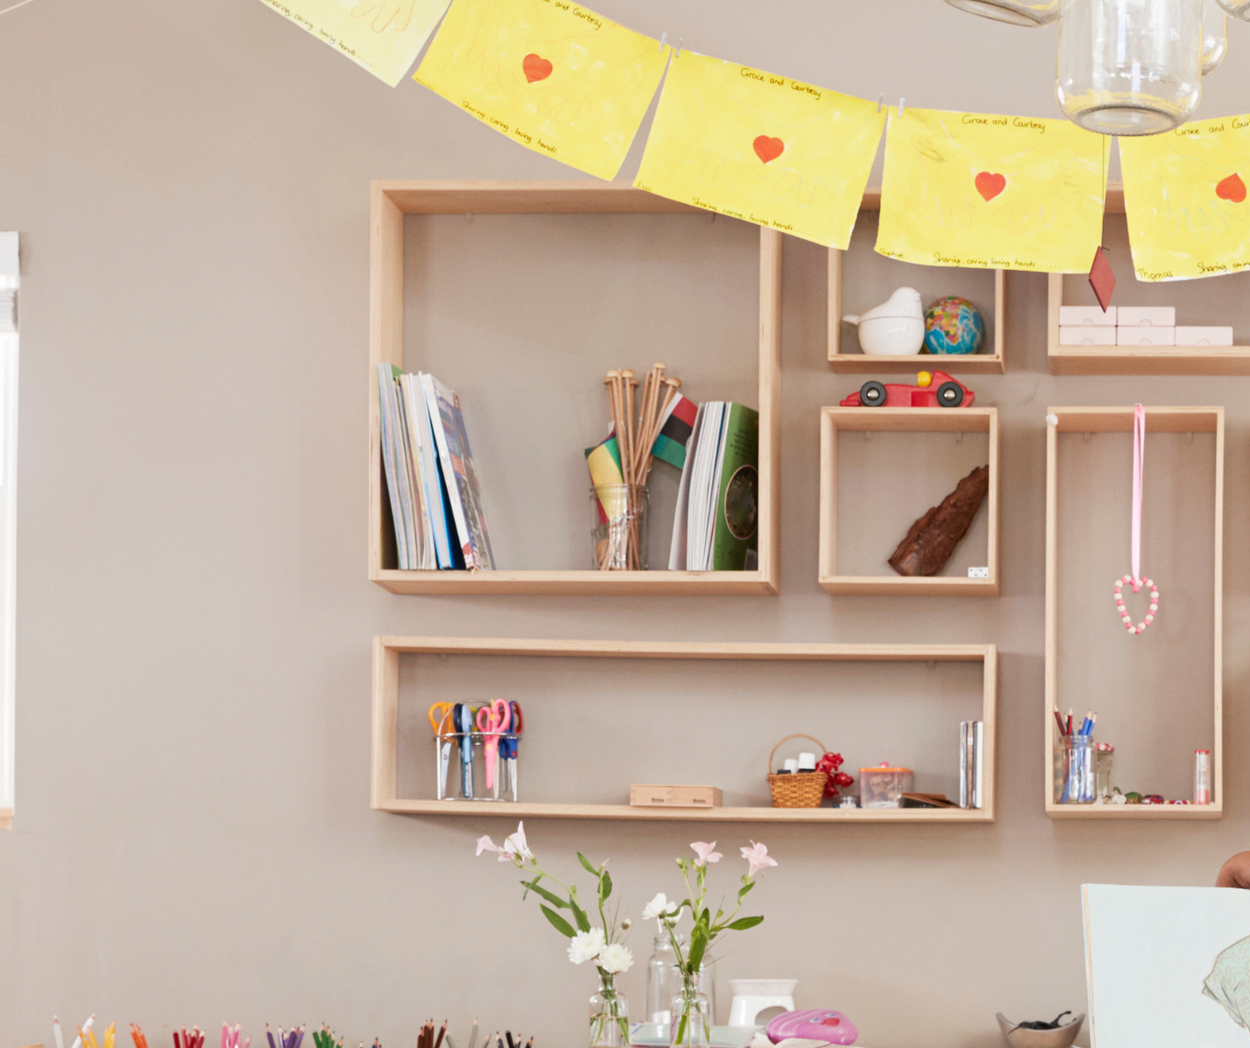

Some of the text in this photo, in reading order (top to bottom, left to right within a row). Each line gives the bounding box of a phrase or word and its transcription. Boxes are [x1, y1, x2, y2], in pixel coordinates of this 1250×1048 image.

[555, 1, 603, 31] and Courtesy
[740, 67, 822, 101] Grace and Courtesy
[961, 114, 1046, 134] Grace and Courtesy
[1174, 126, 1200, 136] Grace
[1209, 124, 1225, 133] and
[1136, 268, 1173, 282] Thomas
